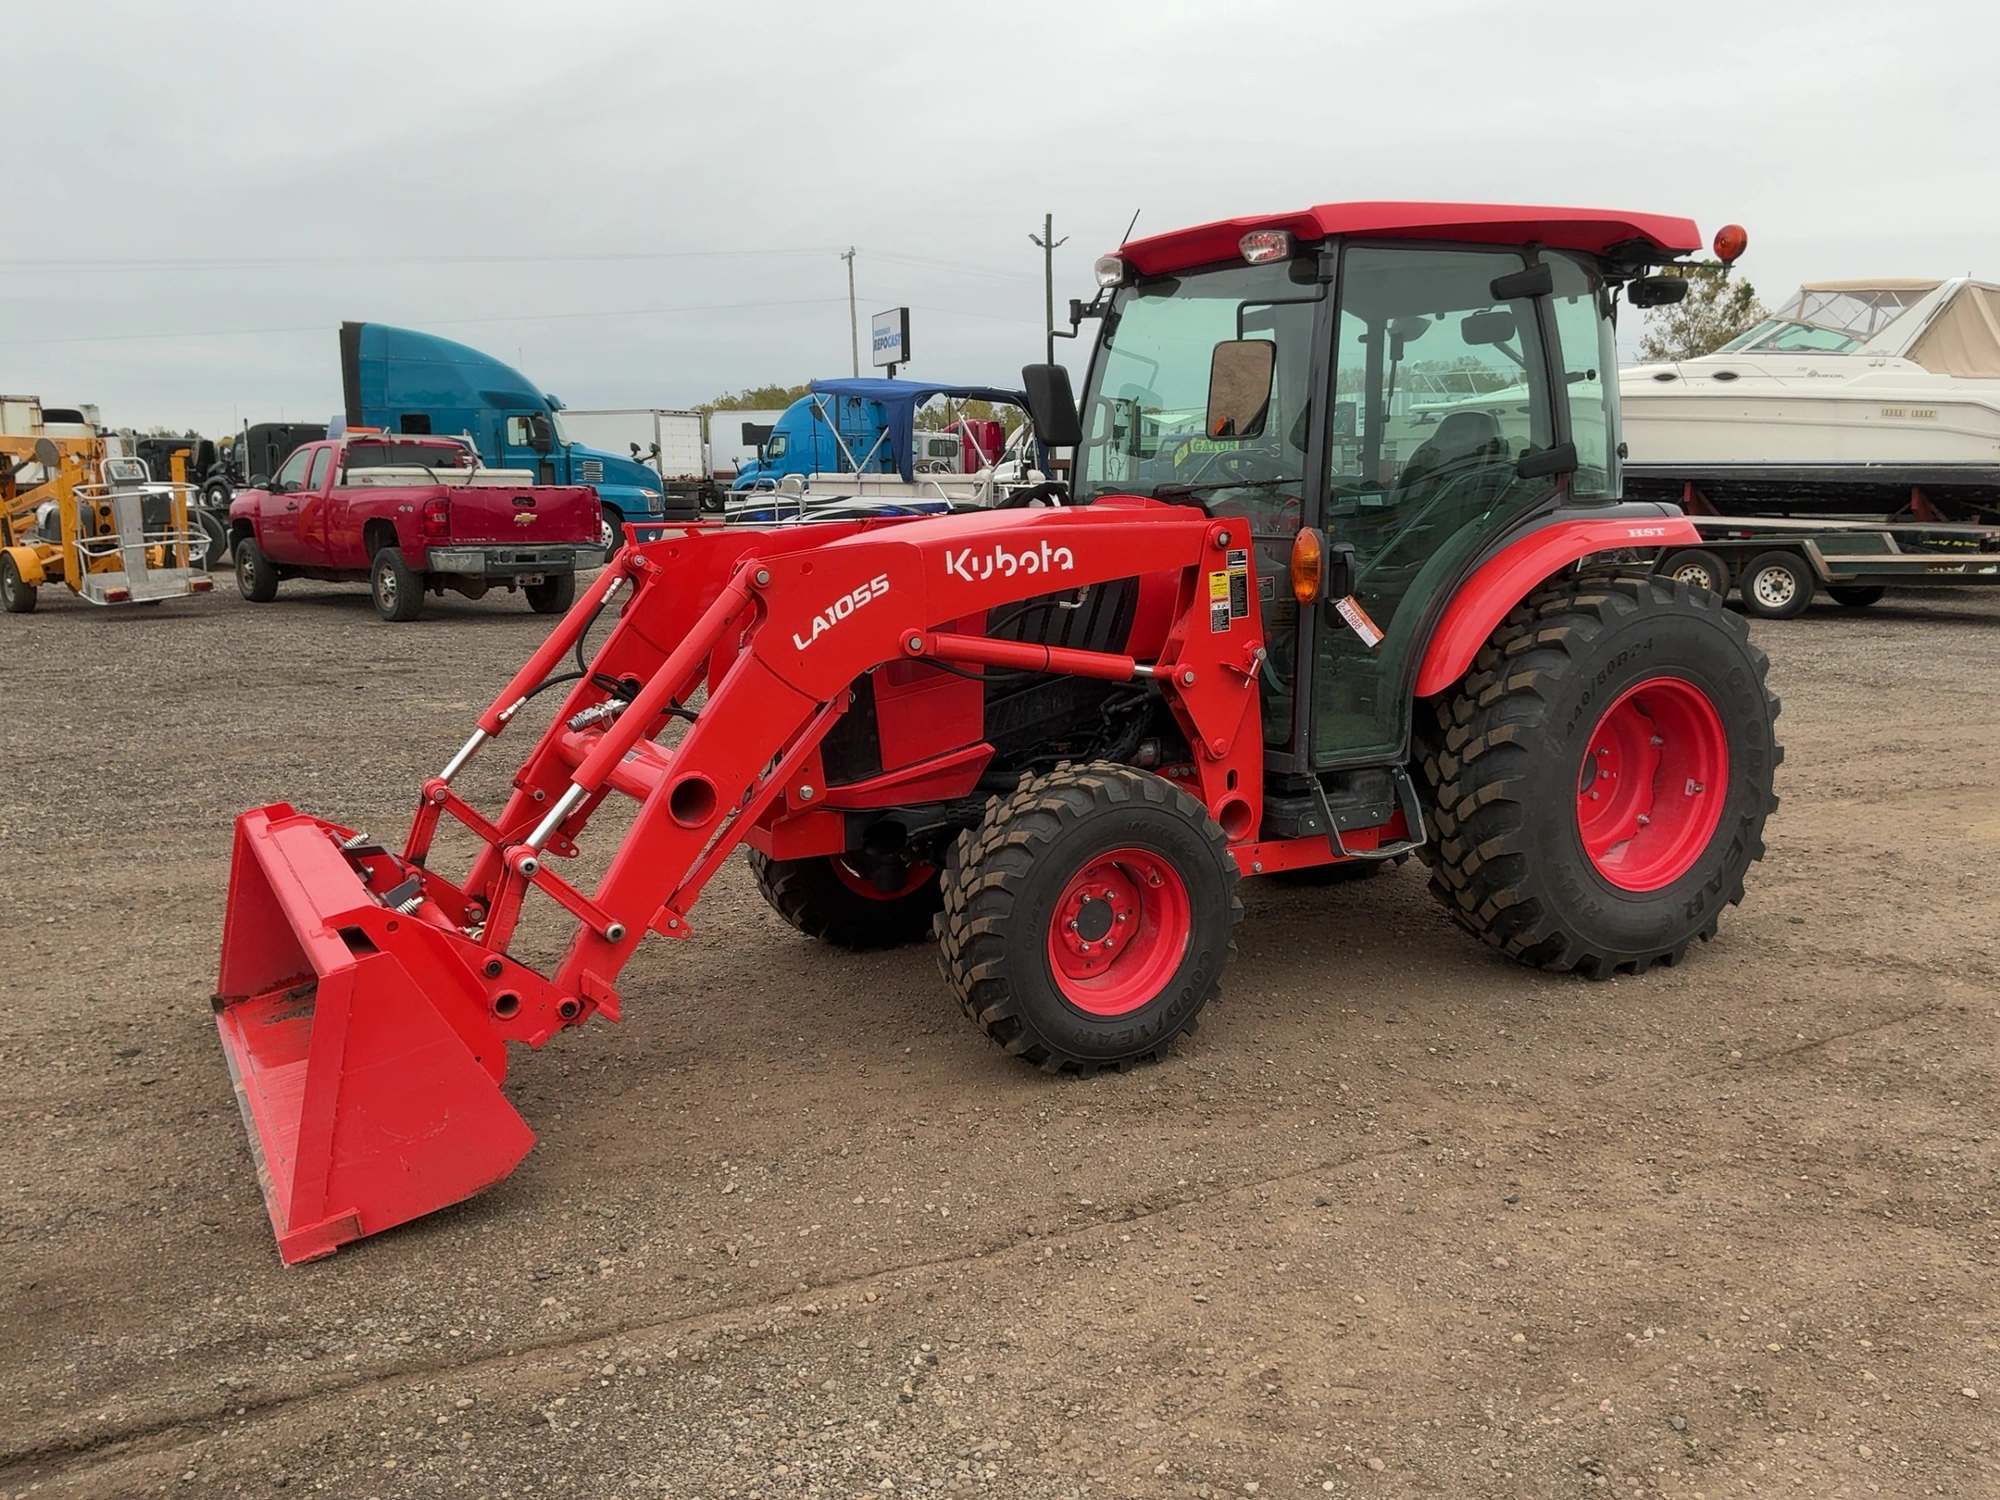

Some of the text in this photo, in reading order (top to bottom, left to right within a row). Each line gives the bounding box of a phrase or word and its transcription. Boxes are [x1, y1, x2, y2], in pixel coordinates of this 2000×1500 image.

[1193, 440, 1238, 452] GATOR
[1627, 527, 1666, 538] HST
[945, 539, 1074, 582] Kubota
[791, 572, 891, 652] LA1055
[1072, 949, 1213, 1048] GOODYEAR
